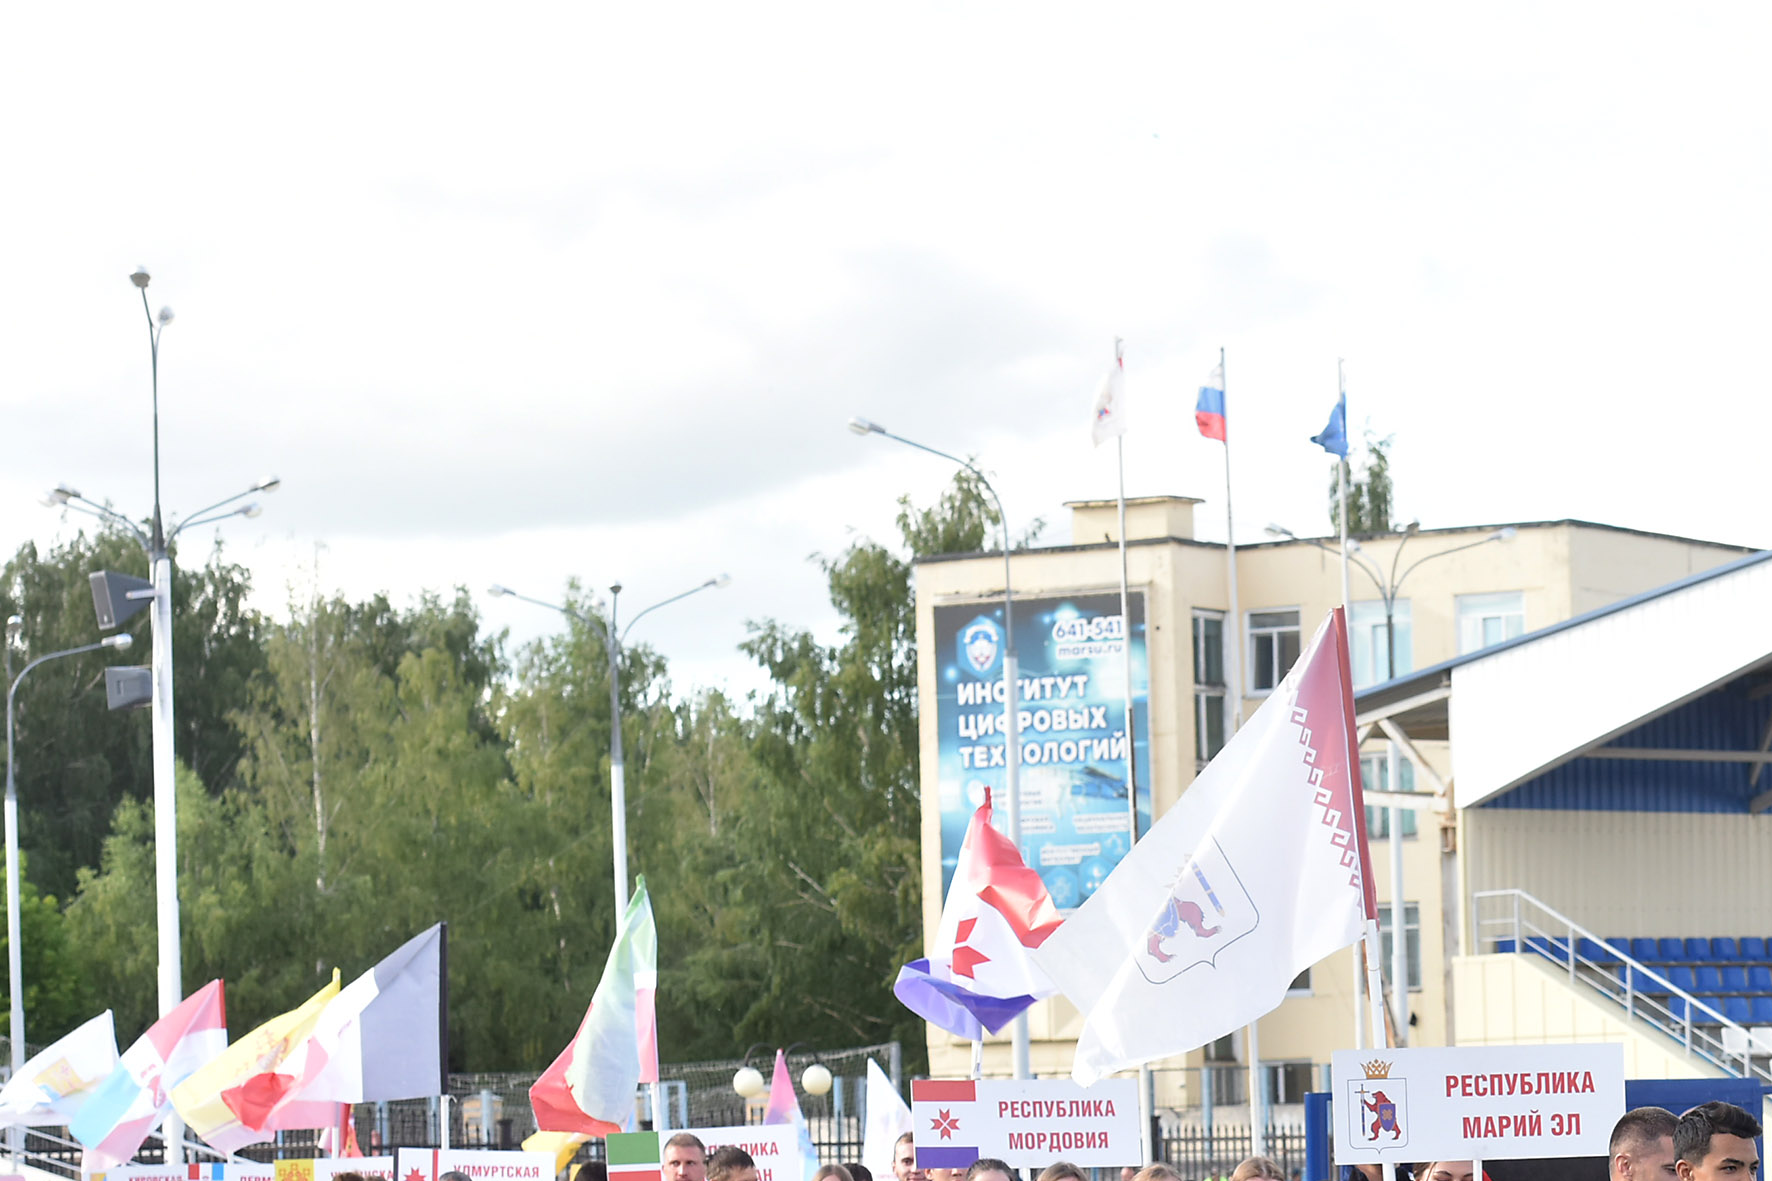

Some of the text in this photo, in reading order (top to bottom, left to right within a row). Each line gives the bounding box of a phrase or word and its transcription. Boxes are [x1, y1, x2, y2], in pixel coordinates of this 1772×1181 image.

[957, 675, 1089, 706] ИНСИТУТ
[959, 731, 1126, 769] ТЕХОЛОГИЙ
[1445, 1071, 1595, 1097] РЕСПУБЛИКА
[998, 1100, 1116, 1118] РЕСПУБЛИКА
[1462, 1109, 1581, 1139] МАРИЙ ЭЛ
[1008, 1131, 1109, 1152] МОРДОВИЯ
